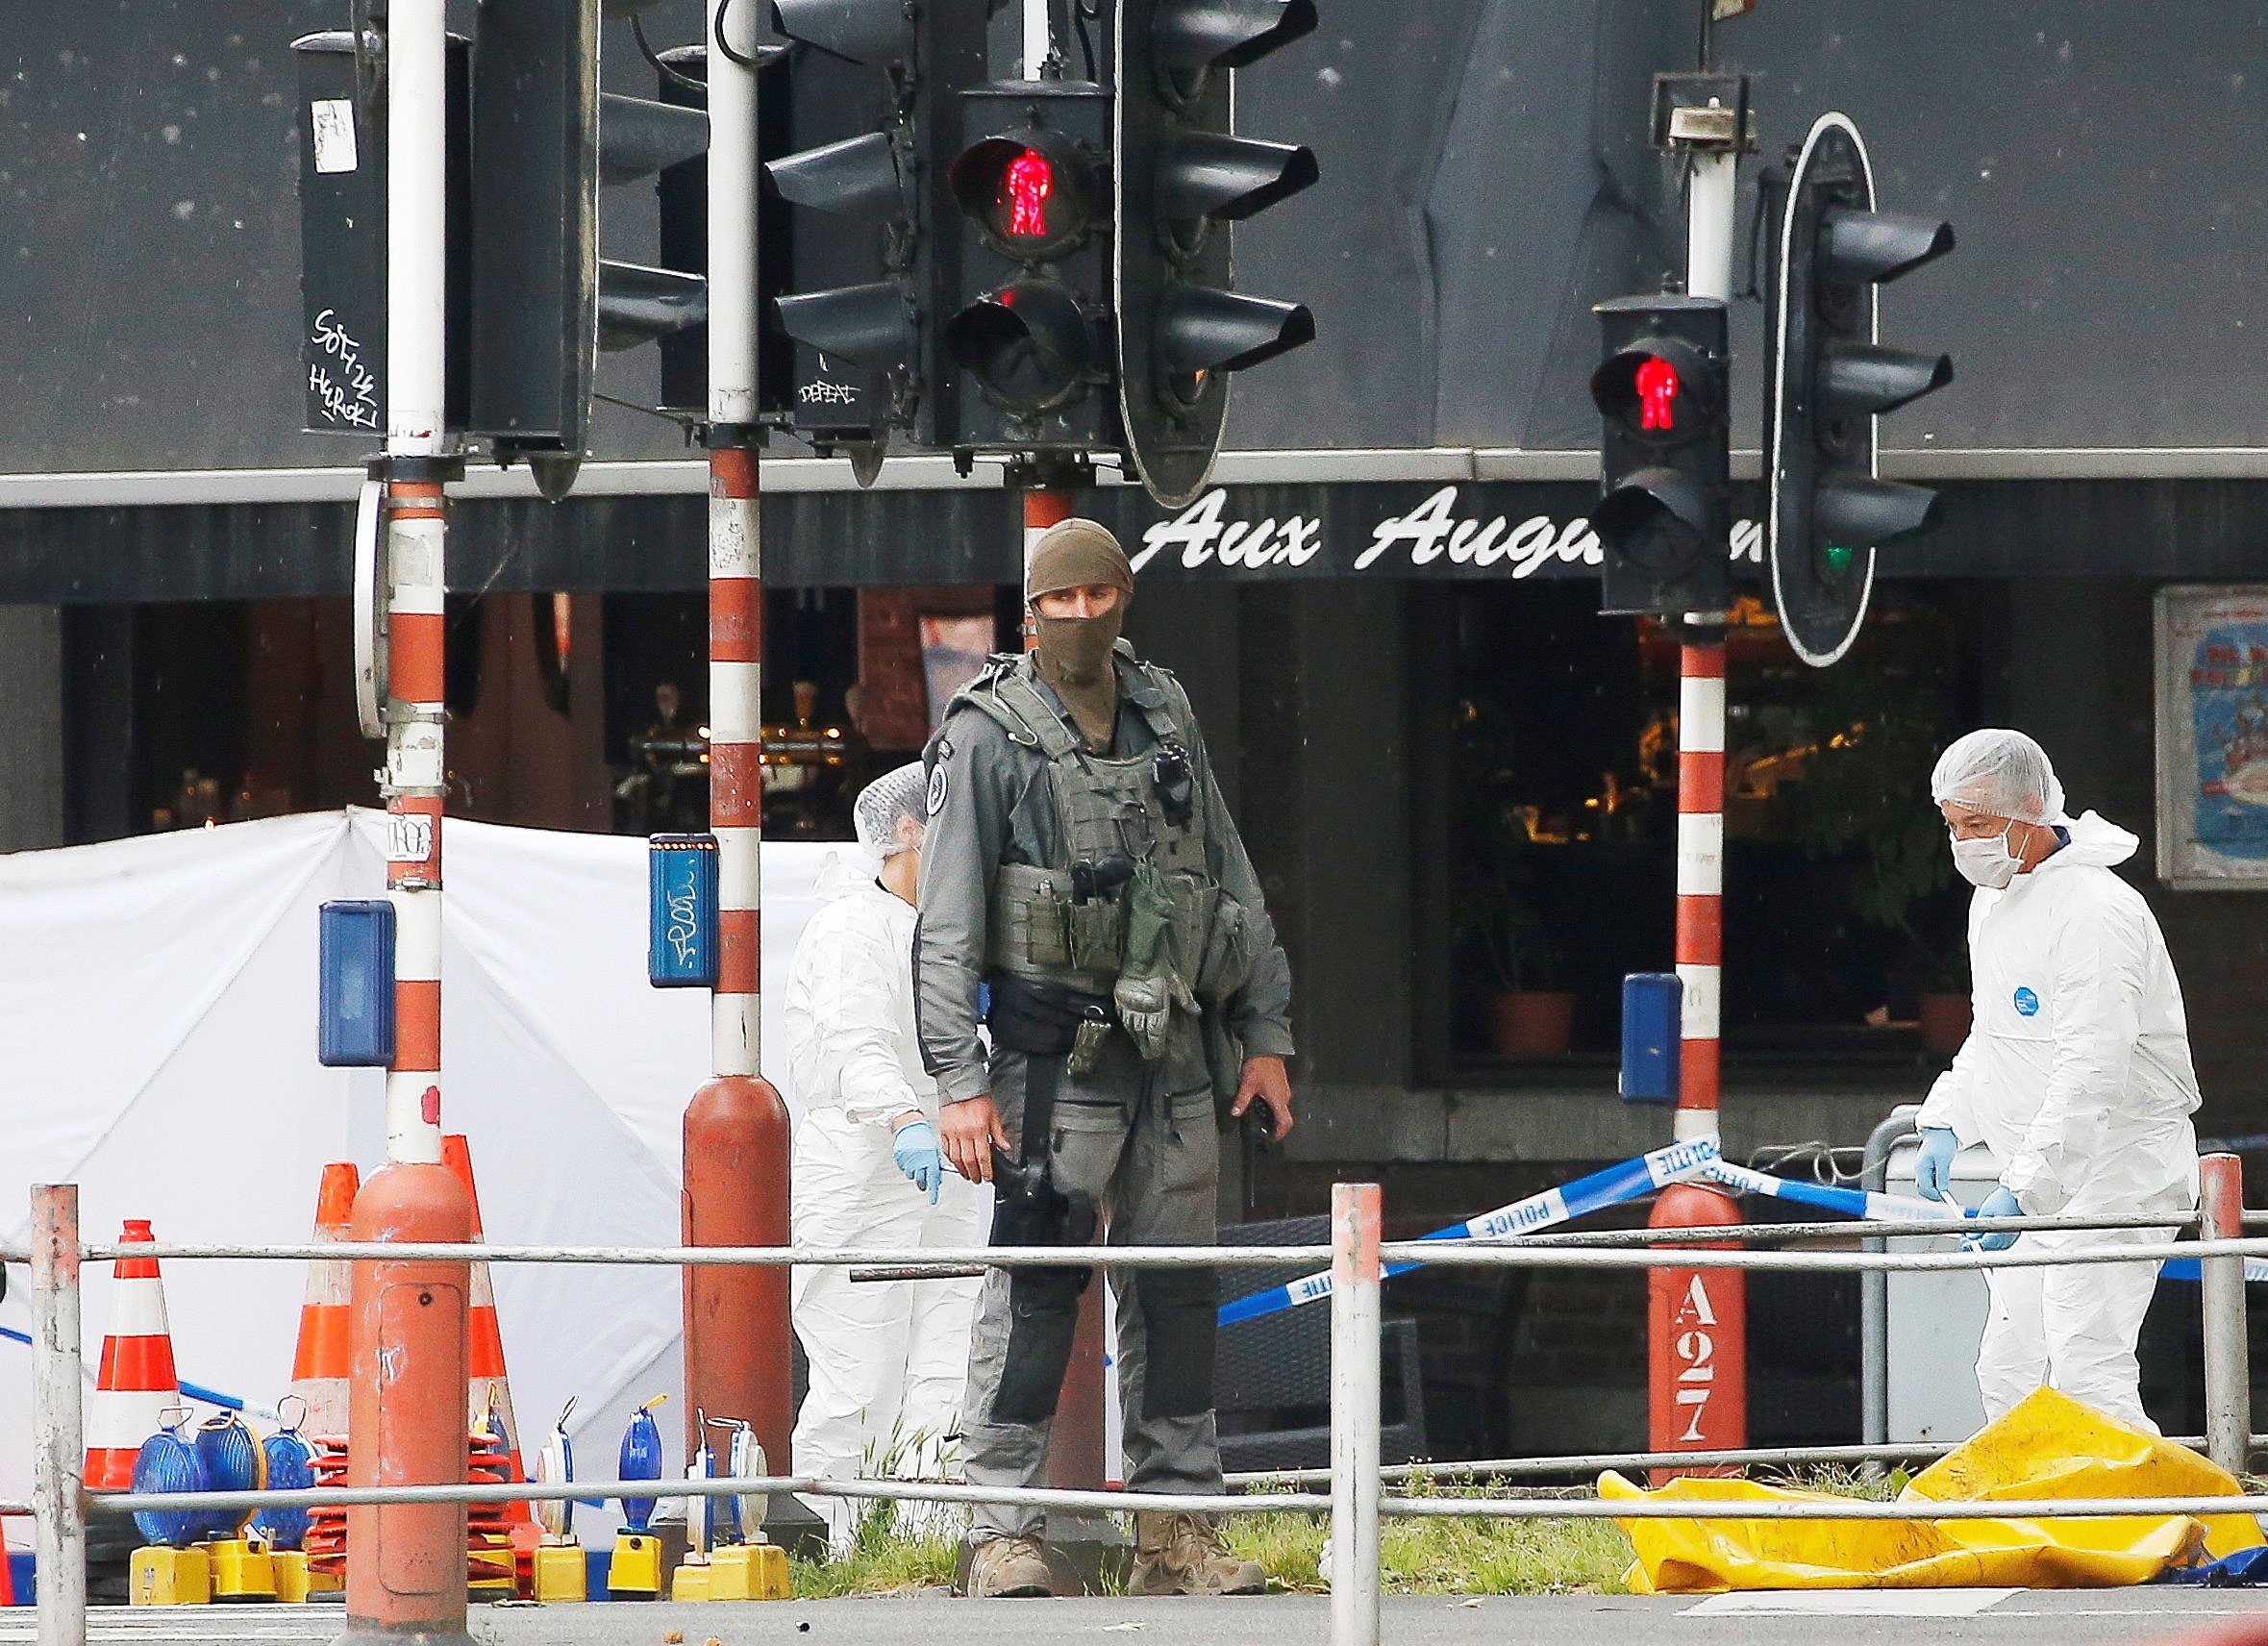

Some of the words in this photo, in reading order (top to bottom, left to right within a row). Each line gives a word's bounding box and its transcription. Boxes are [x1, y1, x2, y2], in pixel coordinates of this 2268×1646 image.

[1129, 487, 1322, 575] Aux
[1483, 1200, 1551, 1238] POLICE
[1674, 1272, 1718, 1442] A27
